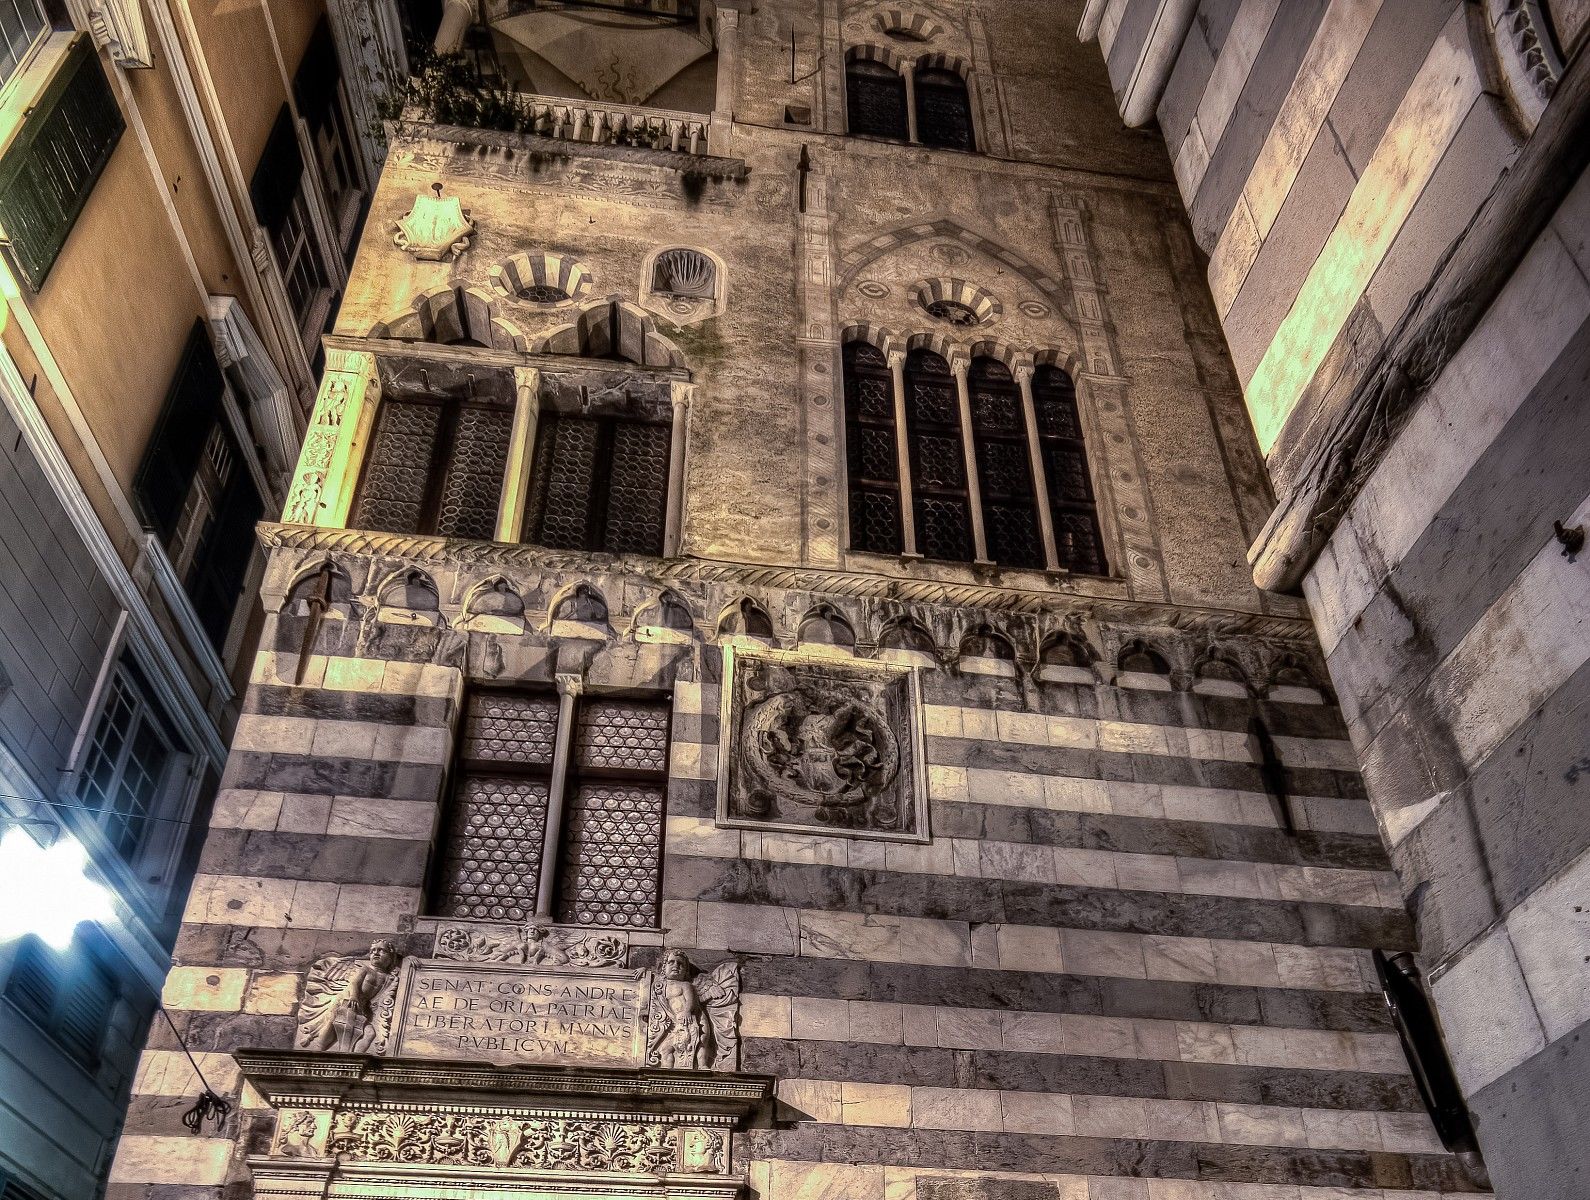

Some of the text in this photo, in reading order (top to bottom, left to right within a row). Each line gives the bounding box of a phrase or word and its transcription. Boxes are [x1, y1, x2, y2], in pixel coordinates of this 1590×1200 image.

[417, 996, 632, 1020] AE DE ORIA PATRIAE
[413, 1014, 632, 1039] LIBERATORI MVNVS
